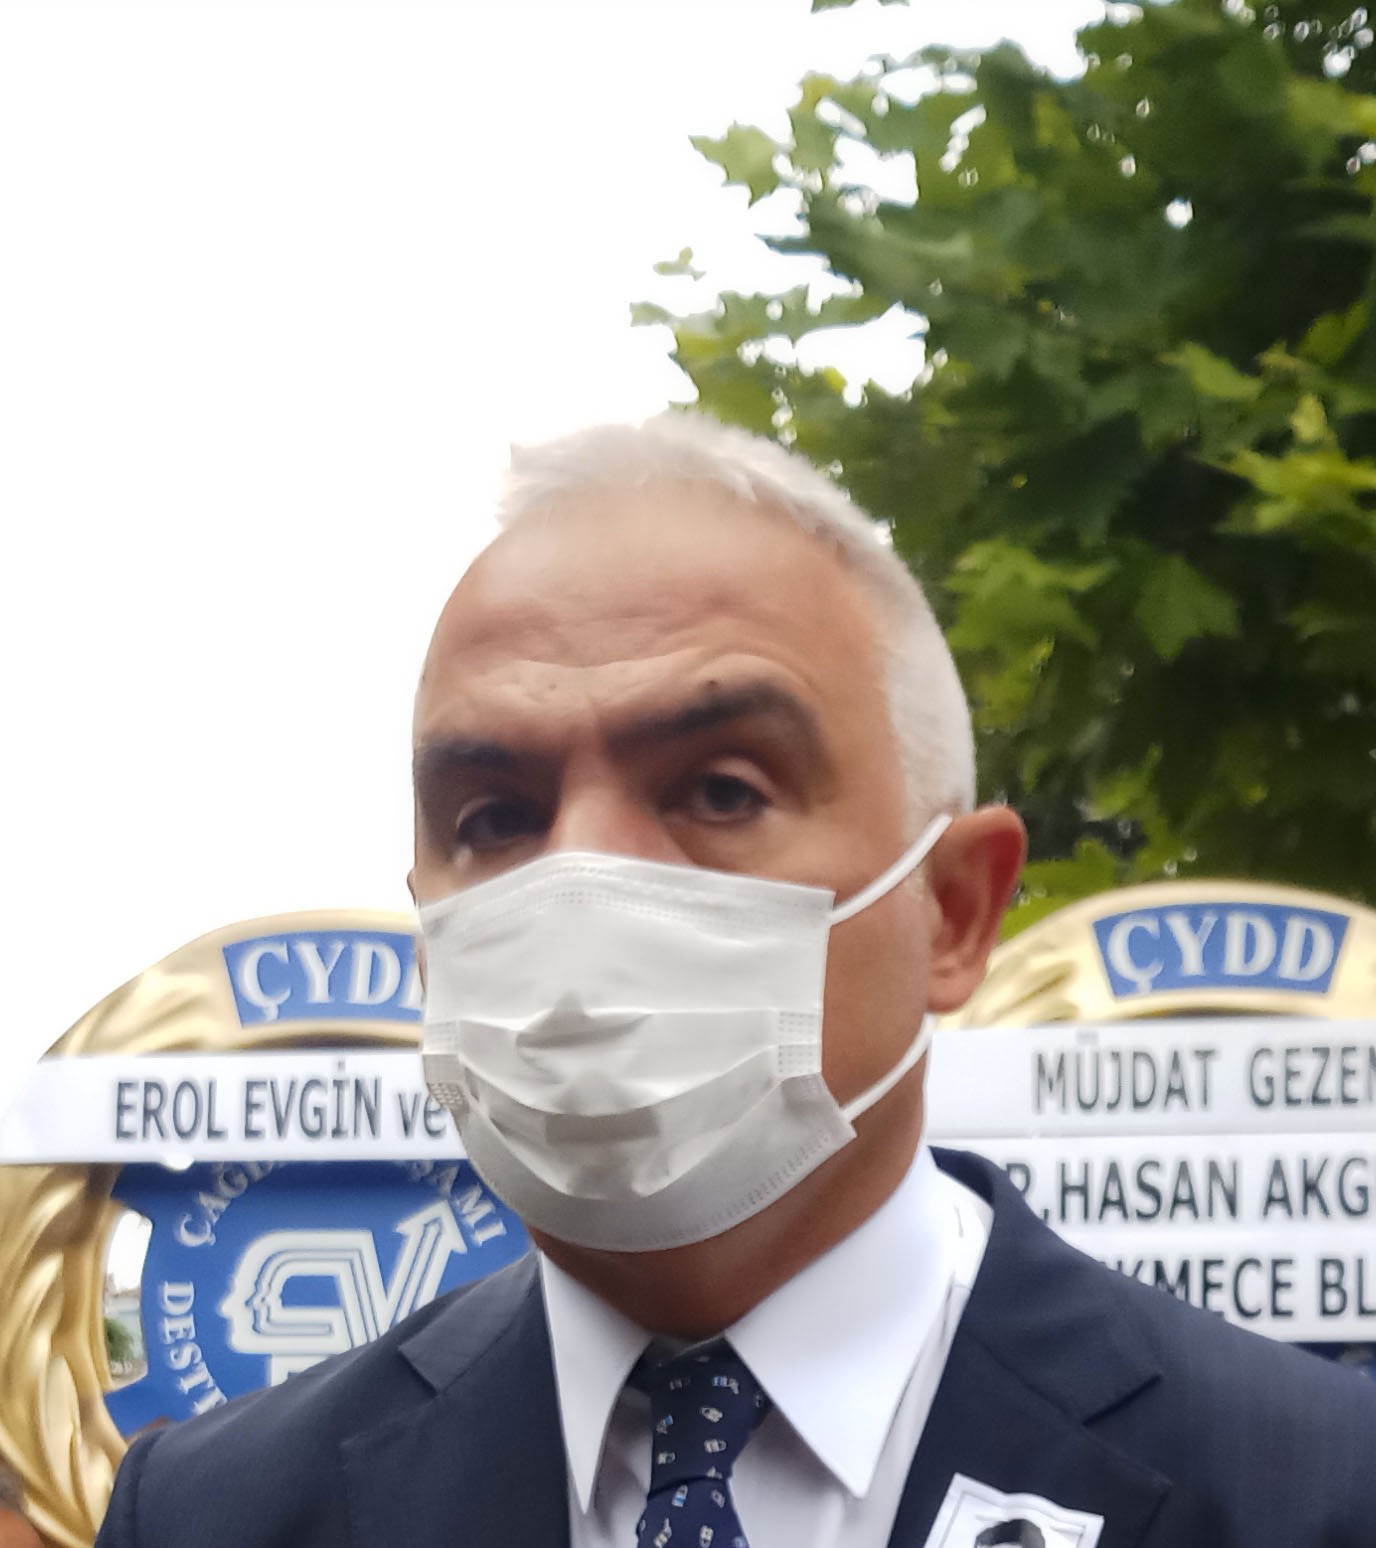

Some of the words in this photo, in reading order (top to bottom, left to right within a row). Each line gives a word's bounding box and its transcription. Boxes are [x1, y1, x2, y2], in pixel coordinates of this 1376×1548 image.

[1106, 912, 1333, 993] ÇYDD
[114, 1079, 228, 1141] EROL
[244, 1060, 381, 1139] EVGİN
[398, 1090, 447, 1138] ve
[1035, 1032, 1217, 1114] MÜJDAT
